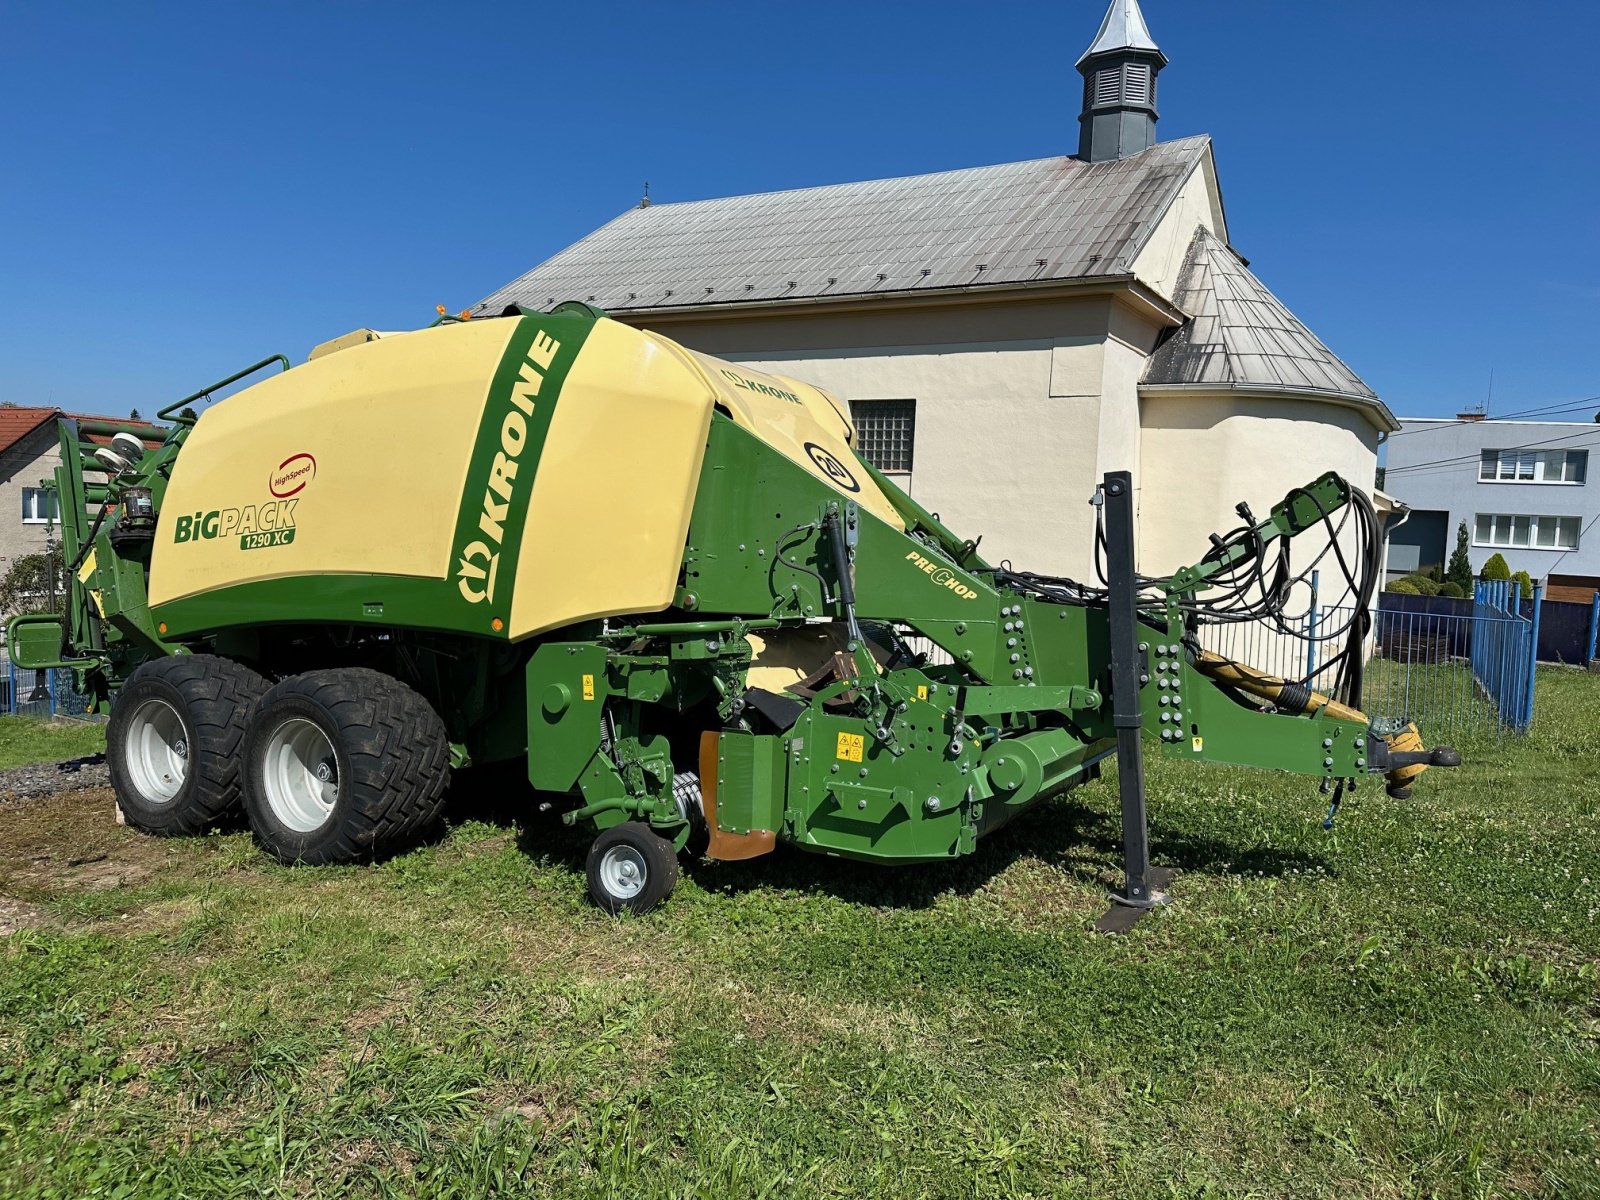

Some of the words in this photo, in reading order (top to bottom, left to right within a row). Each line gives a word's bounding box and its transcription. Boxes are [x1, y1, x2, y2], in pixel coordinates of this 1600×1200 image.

[745, 379, 803, 406] KRONE
[478, 329, 561, 545] KRONE
[274, 463, 311, 487] HighSpeed
[815, 454, 847, 479] 20
[245, 533, 271, 549] 1290
[273, 530, 290, 545] XC
[905, 551, 978, 599] PRECHOP
